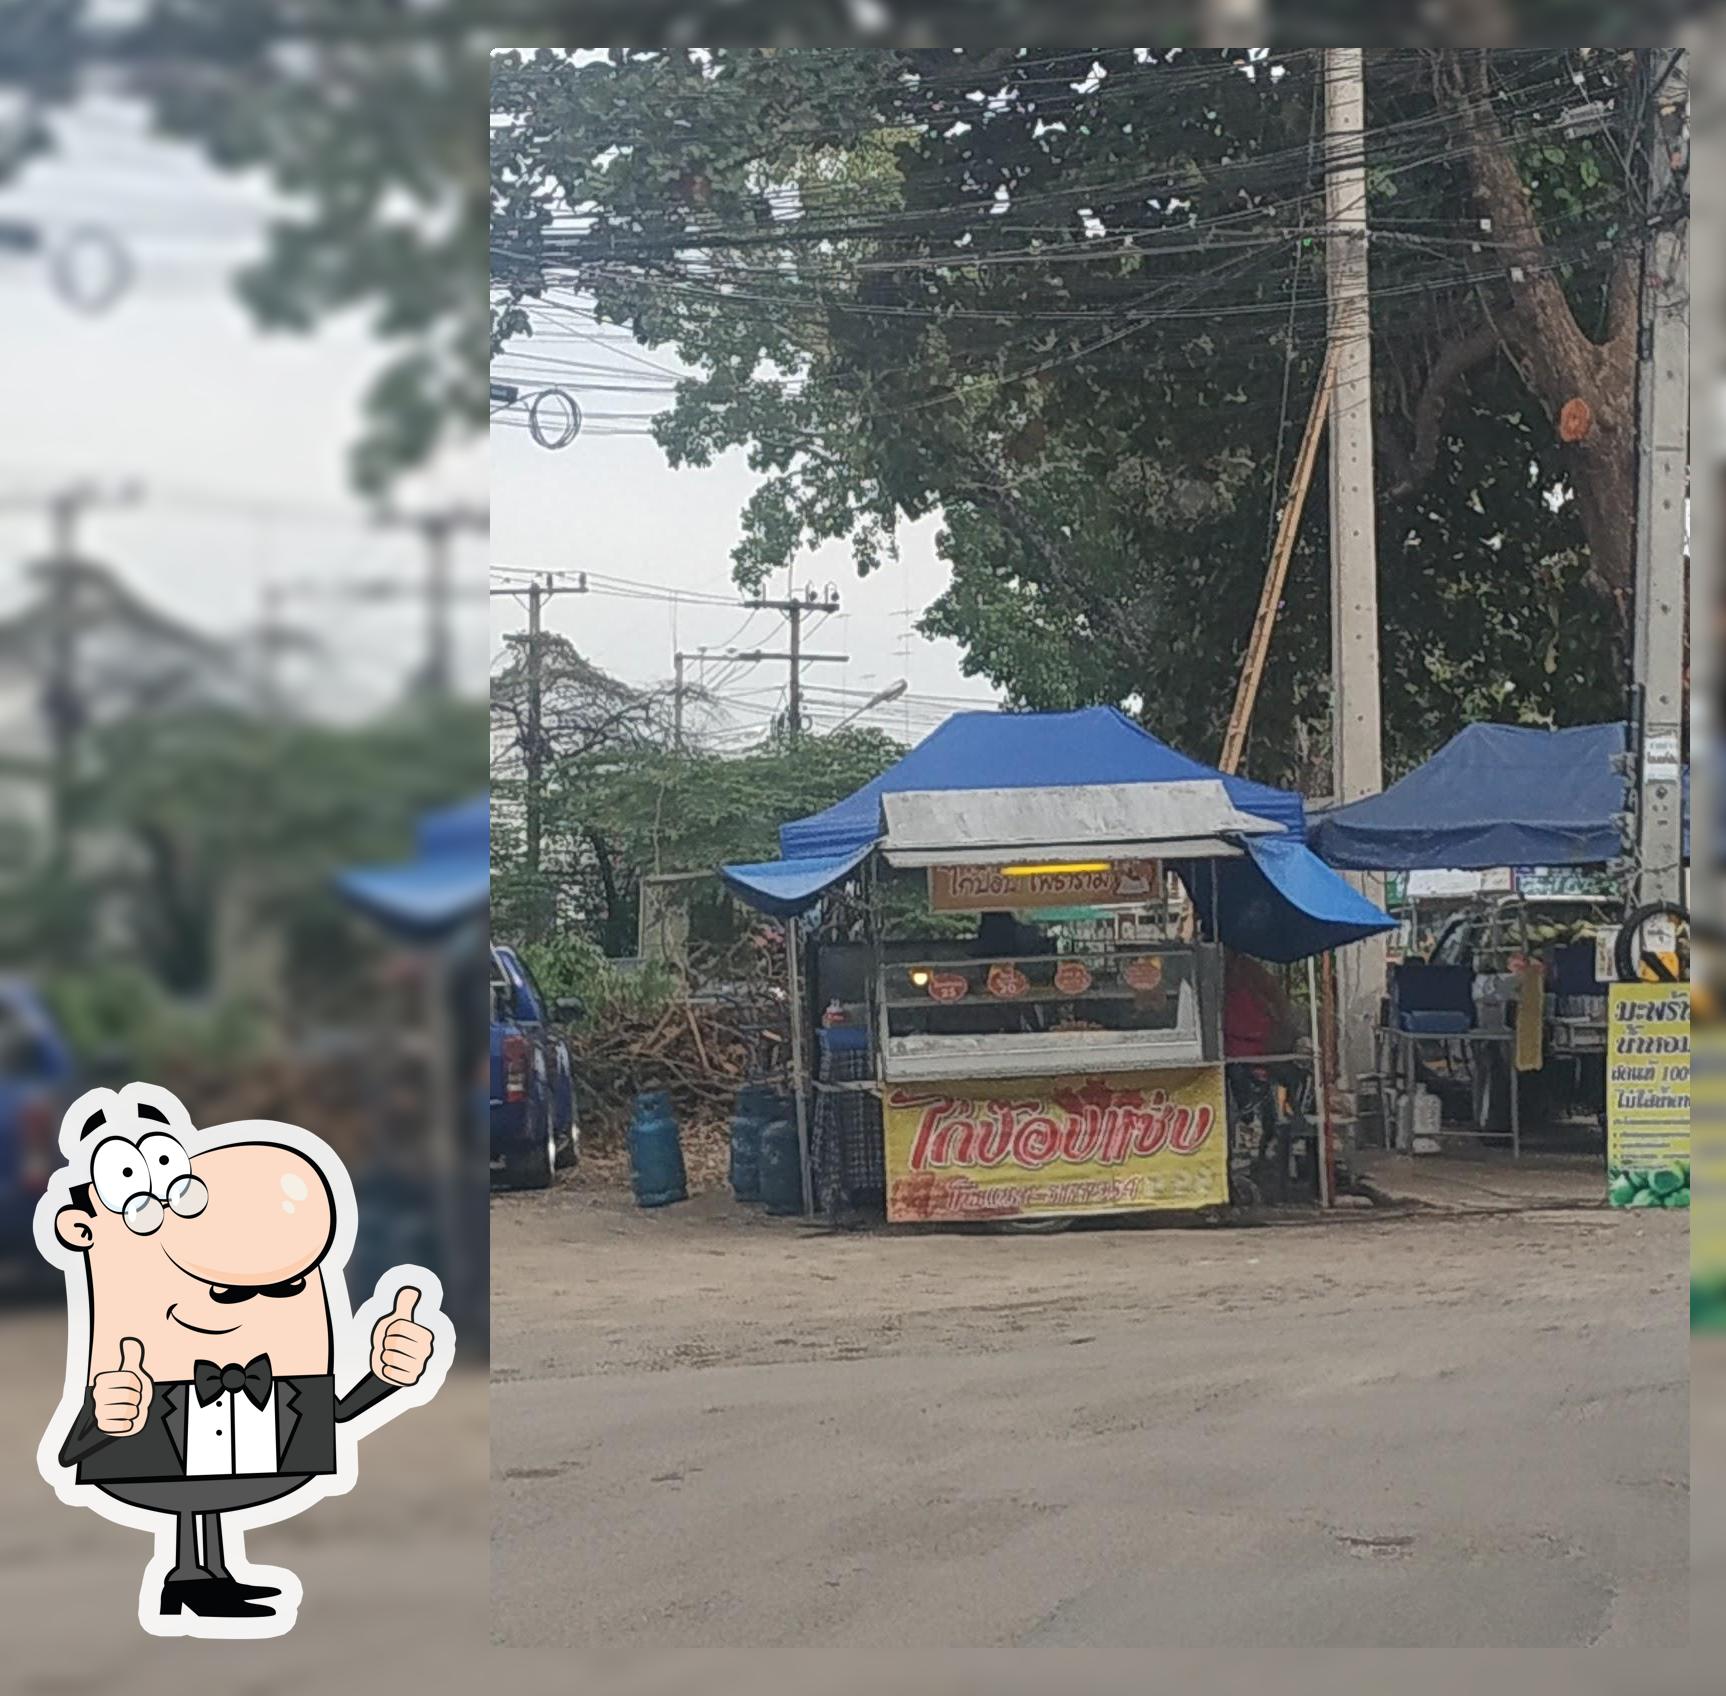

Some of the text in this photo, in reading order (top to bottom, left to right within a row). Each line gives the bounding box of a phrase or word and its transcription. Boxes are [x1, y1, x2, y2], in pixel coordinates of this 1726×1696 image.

[1614, 990, 1690, 1021] มะพร้า
[1662, 1065, 1690, 1081] 100
